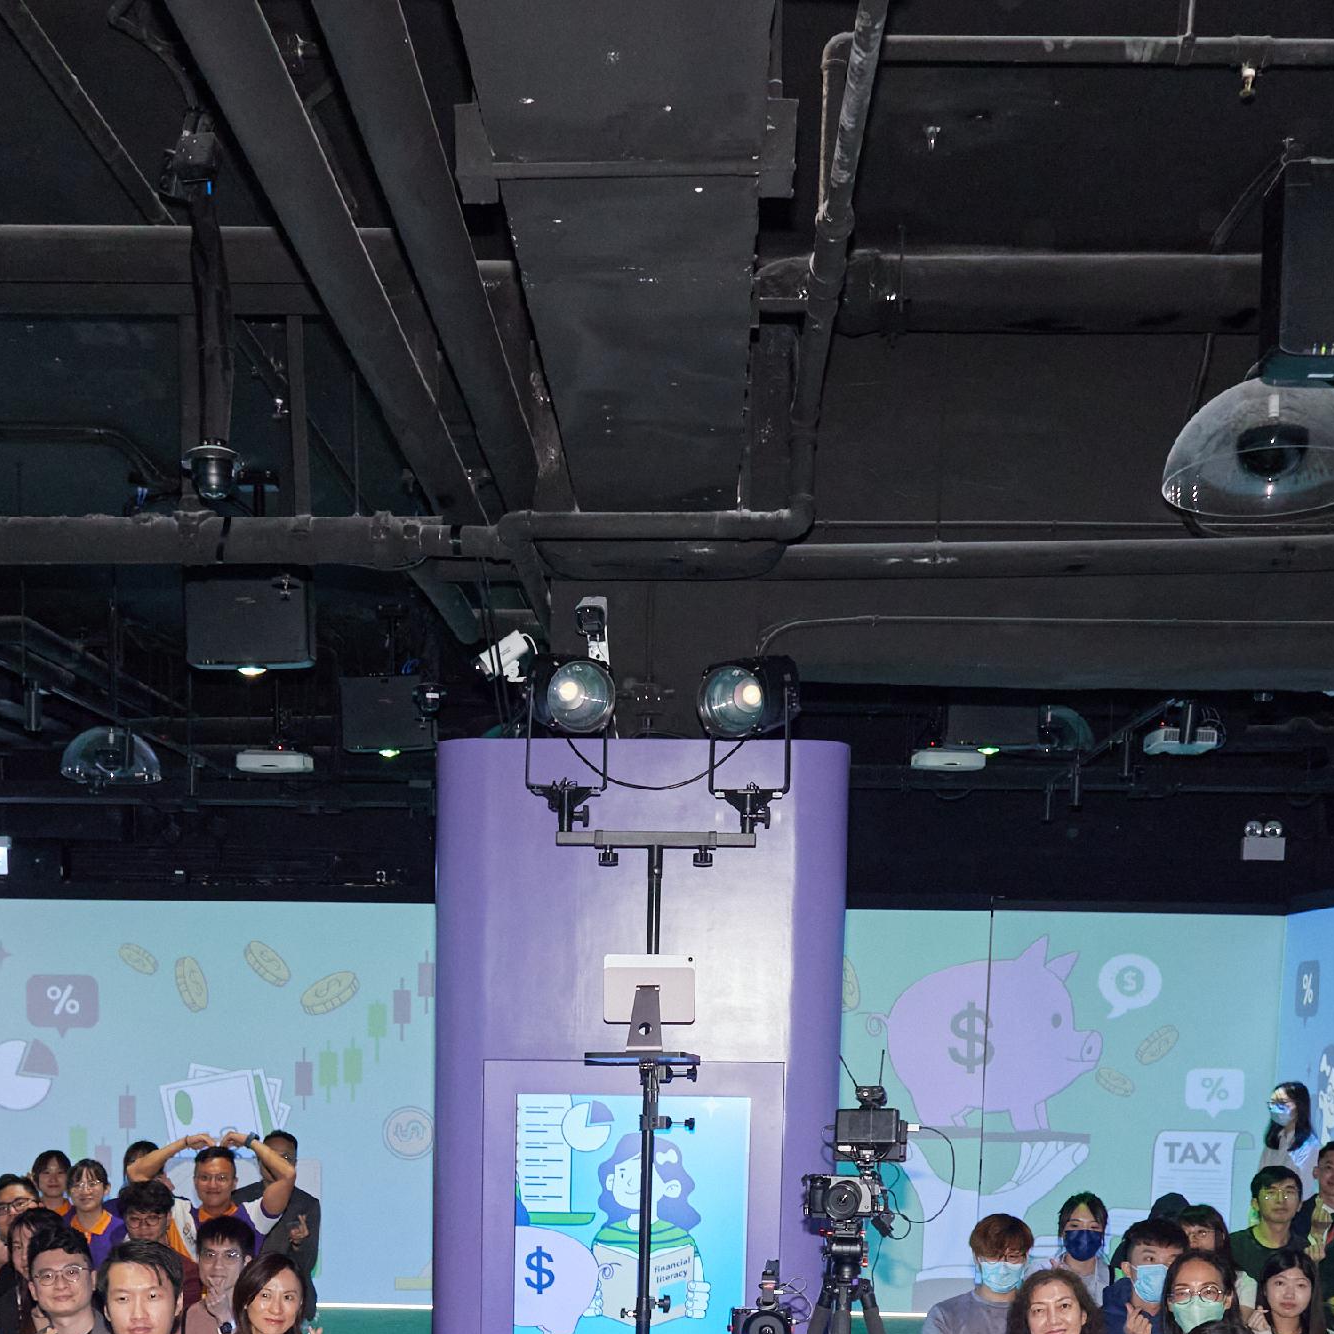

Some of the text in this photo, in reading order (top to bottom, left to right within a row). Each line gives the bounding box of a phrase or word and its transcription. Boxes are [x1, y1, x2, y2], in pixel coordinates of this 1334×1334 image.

[1164, 1142, 1221, 1164] TAX
[654, 1257, 691, 1273] financial
[656, 1269, 688, 1283] literacy
